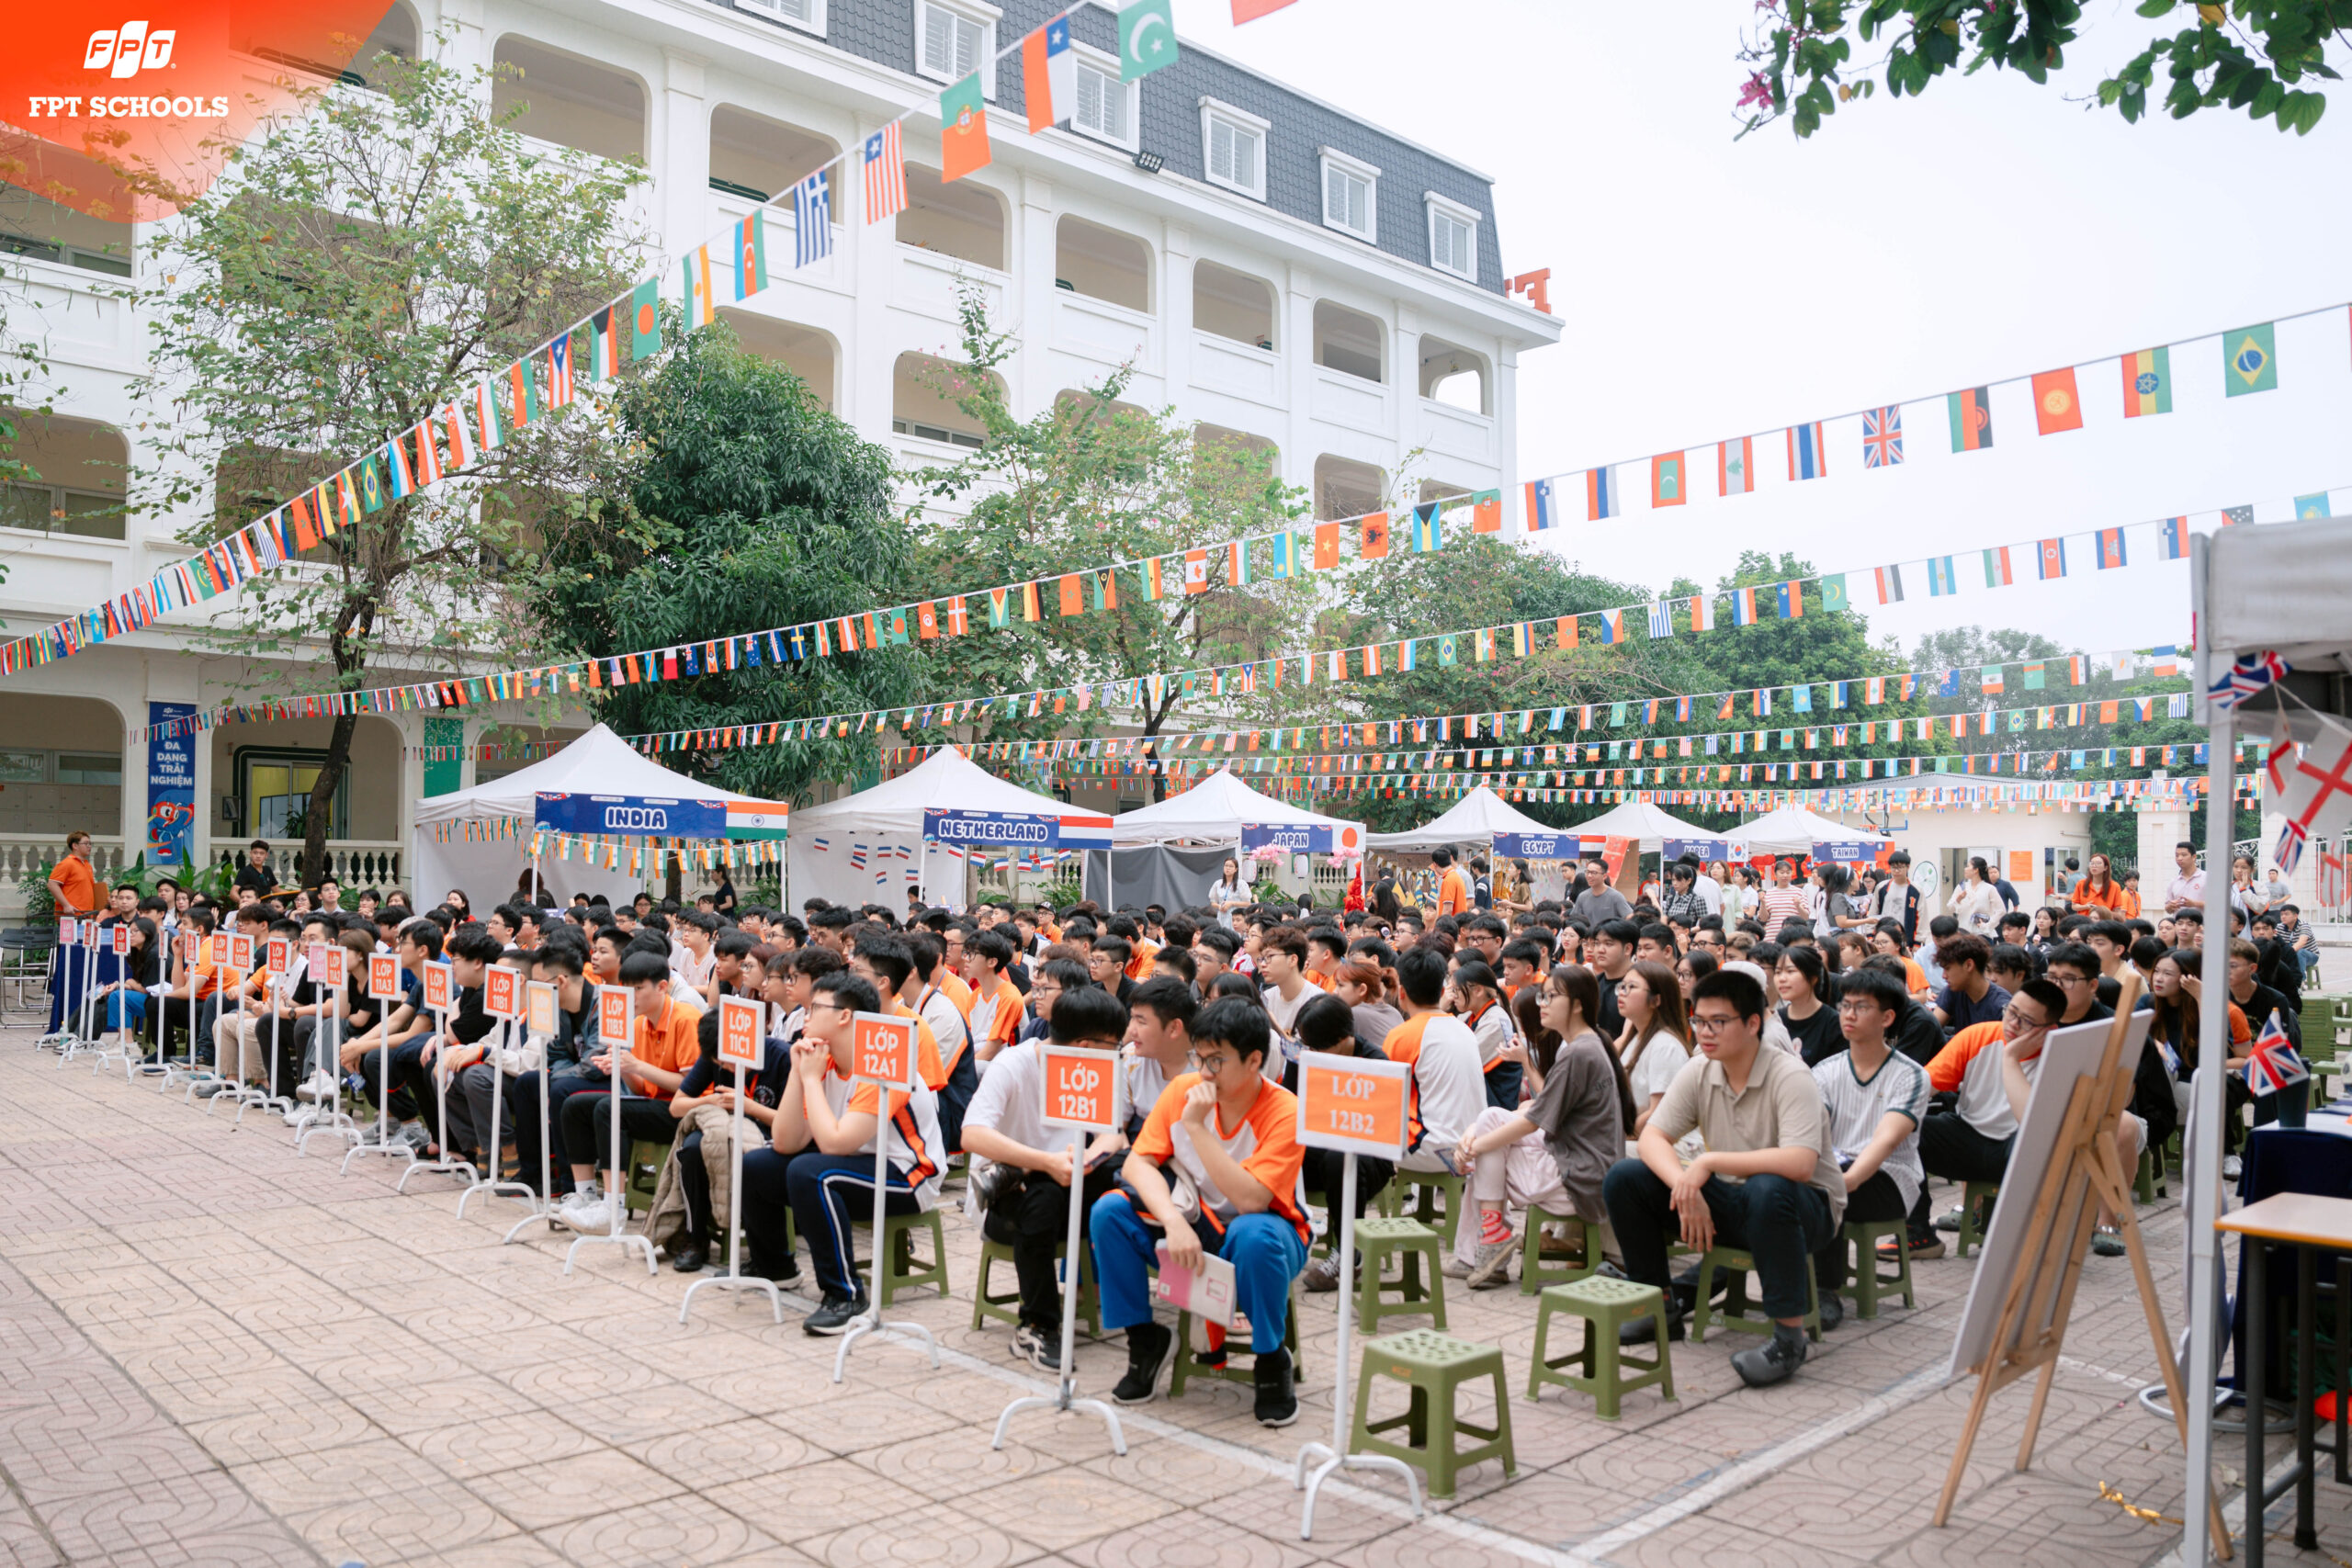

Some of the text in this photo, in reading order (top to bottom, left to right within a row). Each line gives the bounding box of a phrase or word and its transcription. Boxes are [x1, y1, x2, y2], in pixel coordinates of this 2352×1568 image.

[164, 741, 180, 750] ĐA
[157, 753, 187, 763] DẠNG
[160, 763, 185, 773] TRẢI
[151, 775, 193, 787] NGHIỆM
[605, 807, 668, 829] INDIA
[938, 818, 1048, 842] NETHERLAND
[1272, 832, 1309, 849] JAPAN
[1521, 840, 1555, 855] EGYPT
[1831, 848, 1860, 859] TAIWAN
[215, 936, 226, 949] LỚP
[235, 941, 247, 953] LỚP
[330, 953, 340, 968] LỚP
[376, 961, 392, 977] LỚP
[330, 969, 340, 983] 11A2
[429, 969, 444, 987] LỚP
[492, 975, 511, 994] LỚP
[375, 977, 392, 993] 11A3
[429, 987, 446, 1004] 11A4
[492, 995, 509, 1010] 11B1
[606, 995, 624, 1016] LỚP
[605, 1018, 624, 1036] 11B3
[729, 1008, 752, 1032] LỚP
[729, 1033, 751, 1055] 11C1
[865, 1025, 899, 1053] LỚP
[863, 1053, 898, 1077] 12A1
[1059, 1061, 1100, 1093] LỚP
[1331, 1072, 1376, 1100] LỚP
[1058, 1094, 1097, 1121] 12B1
[1329, 1109, 1374, 1134] 12B2
